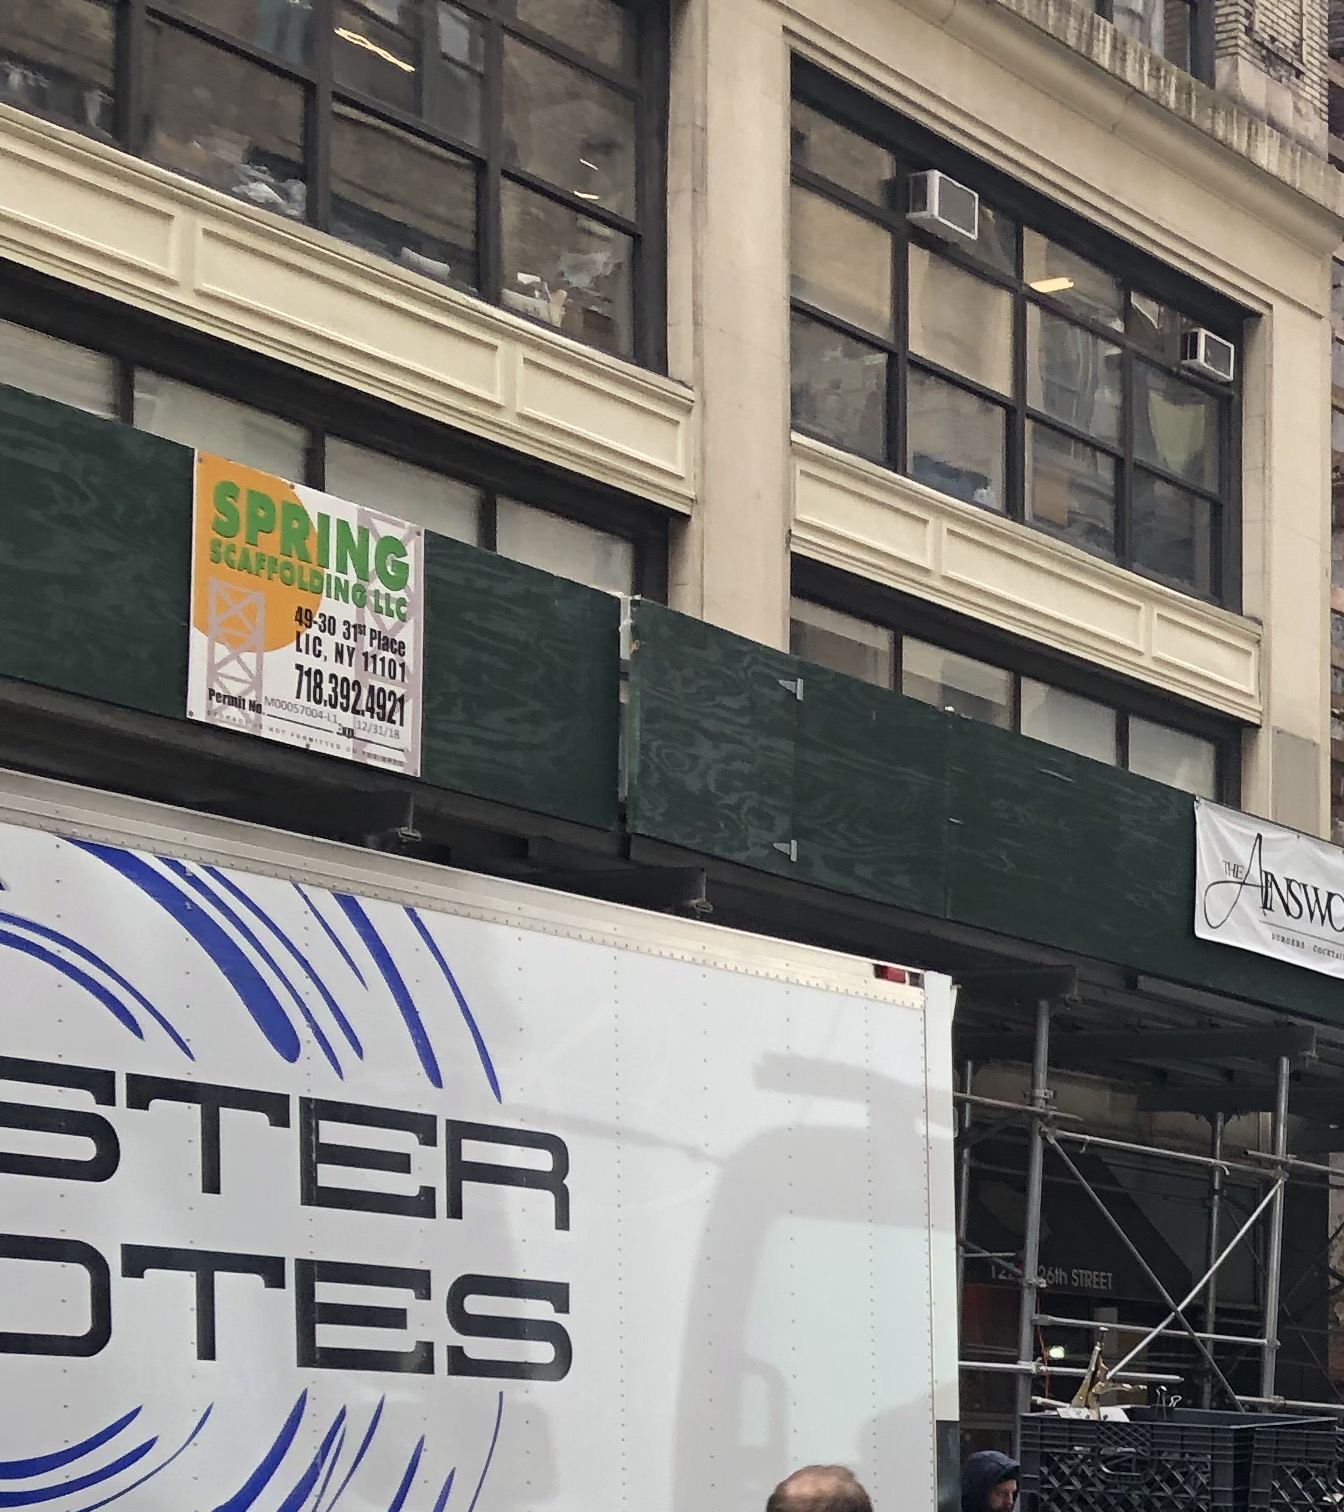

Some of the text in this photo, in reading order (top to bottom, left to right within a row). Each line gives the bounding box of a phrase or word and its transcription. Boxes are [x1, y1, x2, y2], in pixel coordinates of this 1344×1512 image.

[212, 480, 410, 592] SPRING
[209, 538, 407, 622] SCAFFOLDING LLC
[294, 606, 406, 657] 49-30 31st Place
[295, 631, 406, 683] LIC, NY 11101
[208, 688, 246, 710] Permit
[249, 699, 266, 716] No.
[356, 720, 400, 740] 12/31/18
[294, 663, 405, 727] 718.392.4921
[1222, 860, 1244, 880] THE
[1071, 1268, 1114, 1291] STREET
